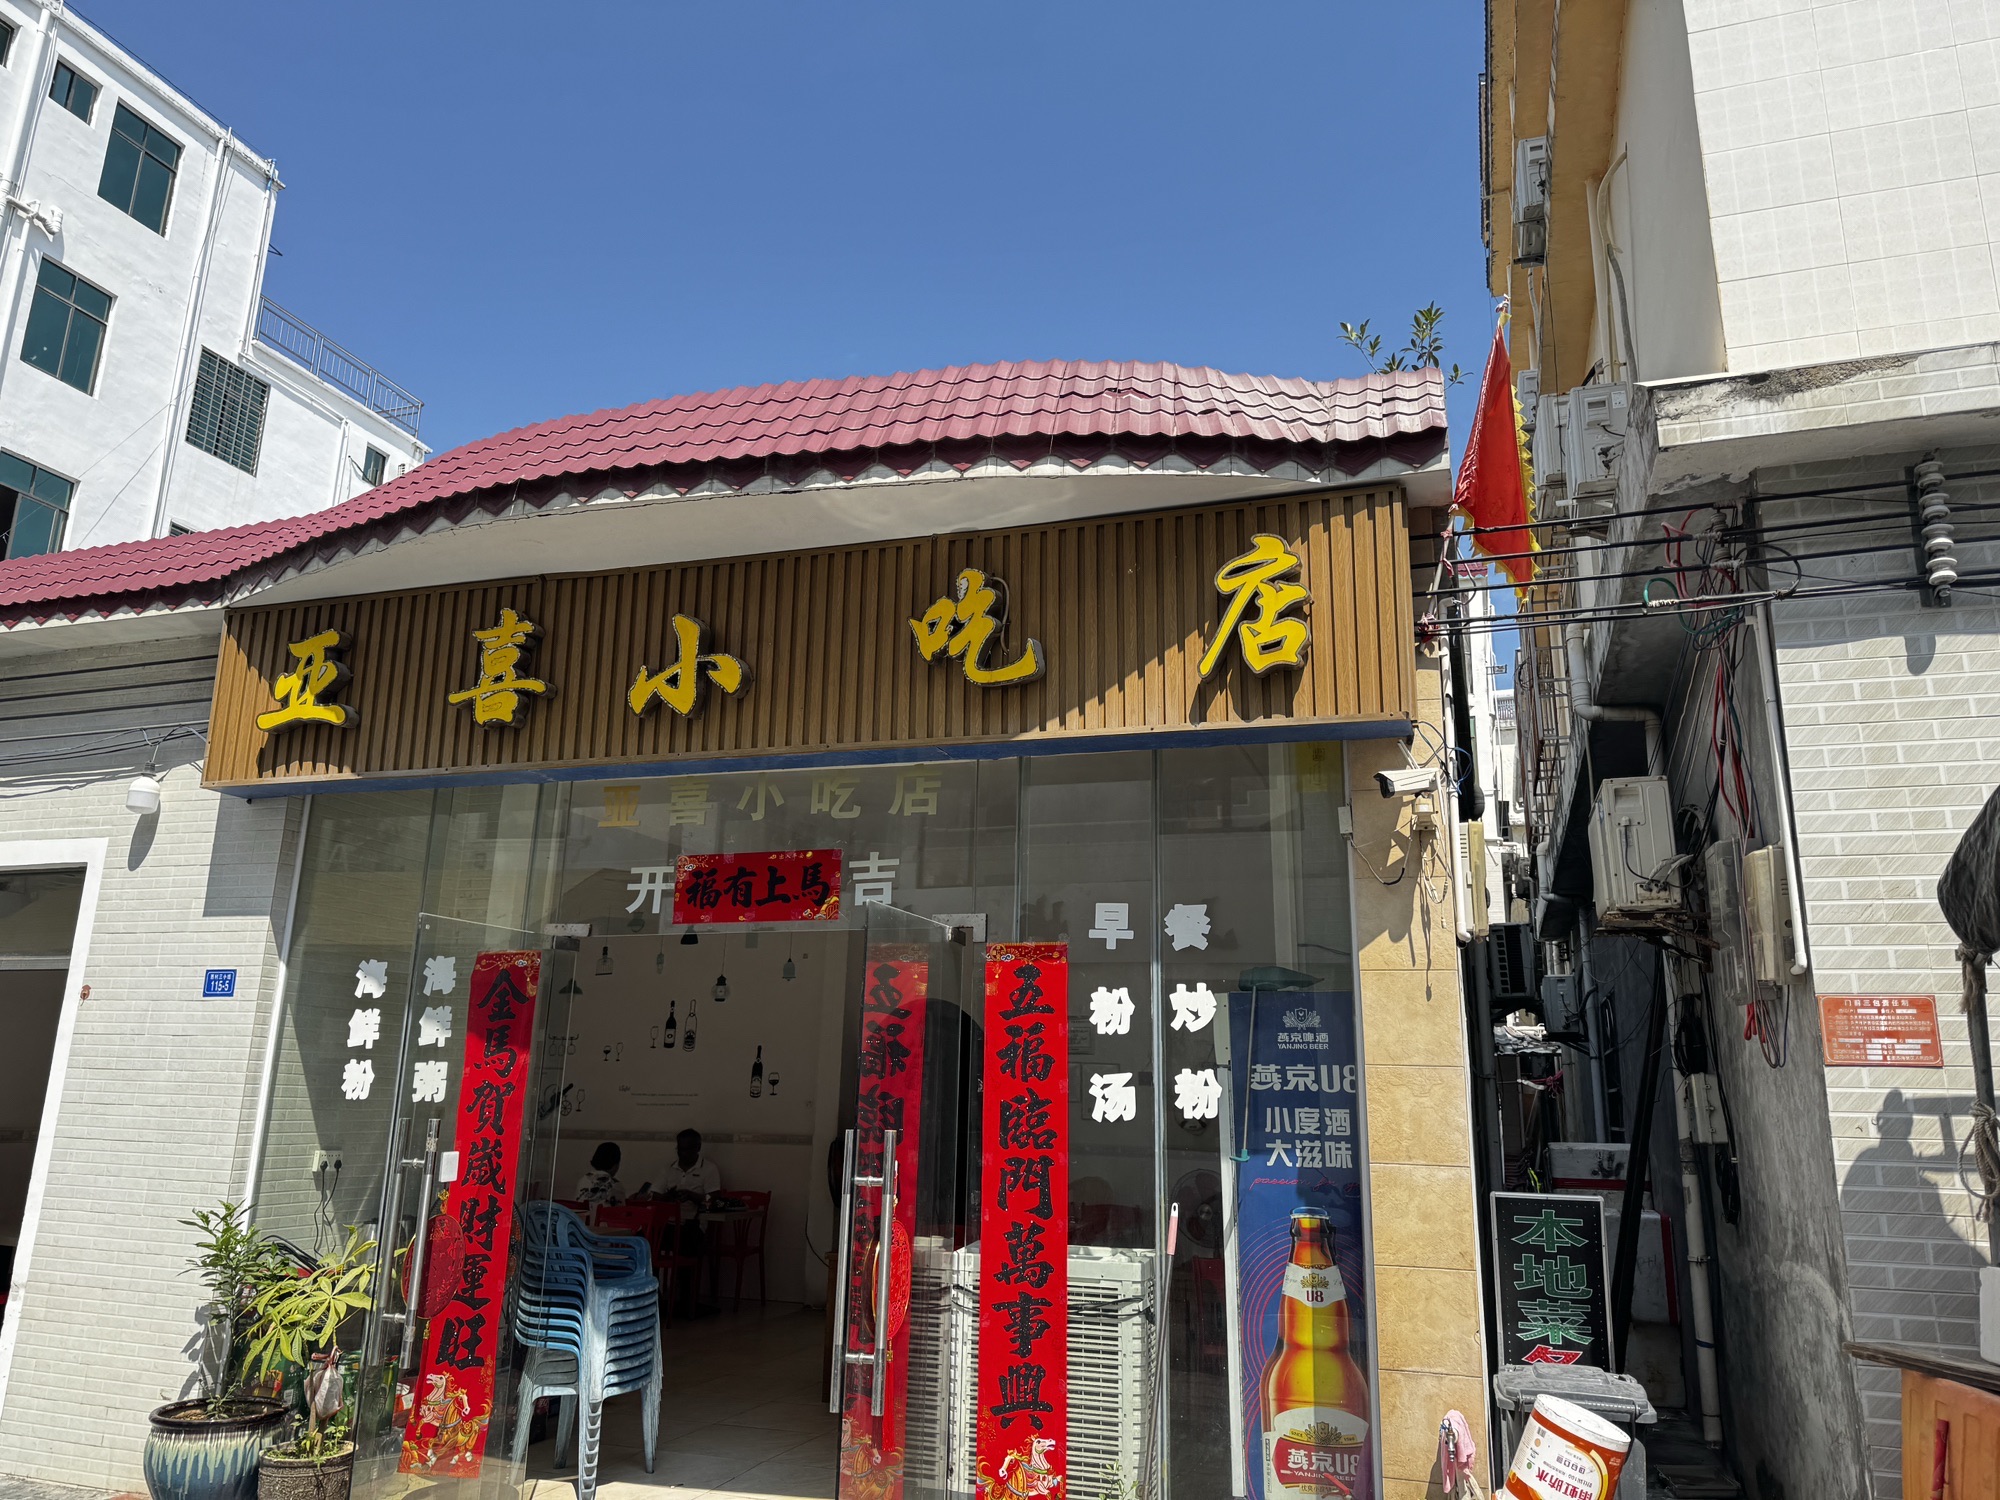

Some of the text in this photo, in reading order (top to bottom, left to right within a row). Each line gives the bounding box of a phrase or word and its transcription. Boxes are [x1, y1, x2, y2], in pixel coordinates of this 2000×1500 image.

[256, 533, 1311, 734] 亚喜小吃店
[598, 768, 942, 827] 亚喜小吃店
[340, 959, 388, 1101] 海鲜粉
[412, 955, 457, 1103] 海鲜粥
[1277, 1032, 1329, 1043] 燕京啤酒
[1265, 1106, 1351, 1136] 小度酒
[1265, 1139, 1353, 1169] 大滋味
[1306, 1290, 1325, 1303] U8
[1294, 1470, 1326, 1479] YANJIN
